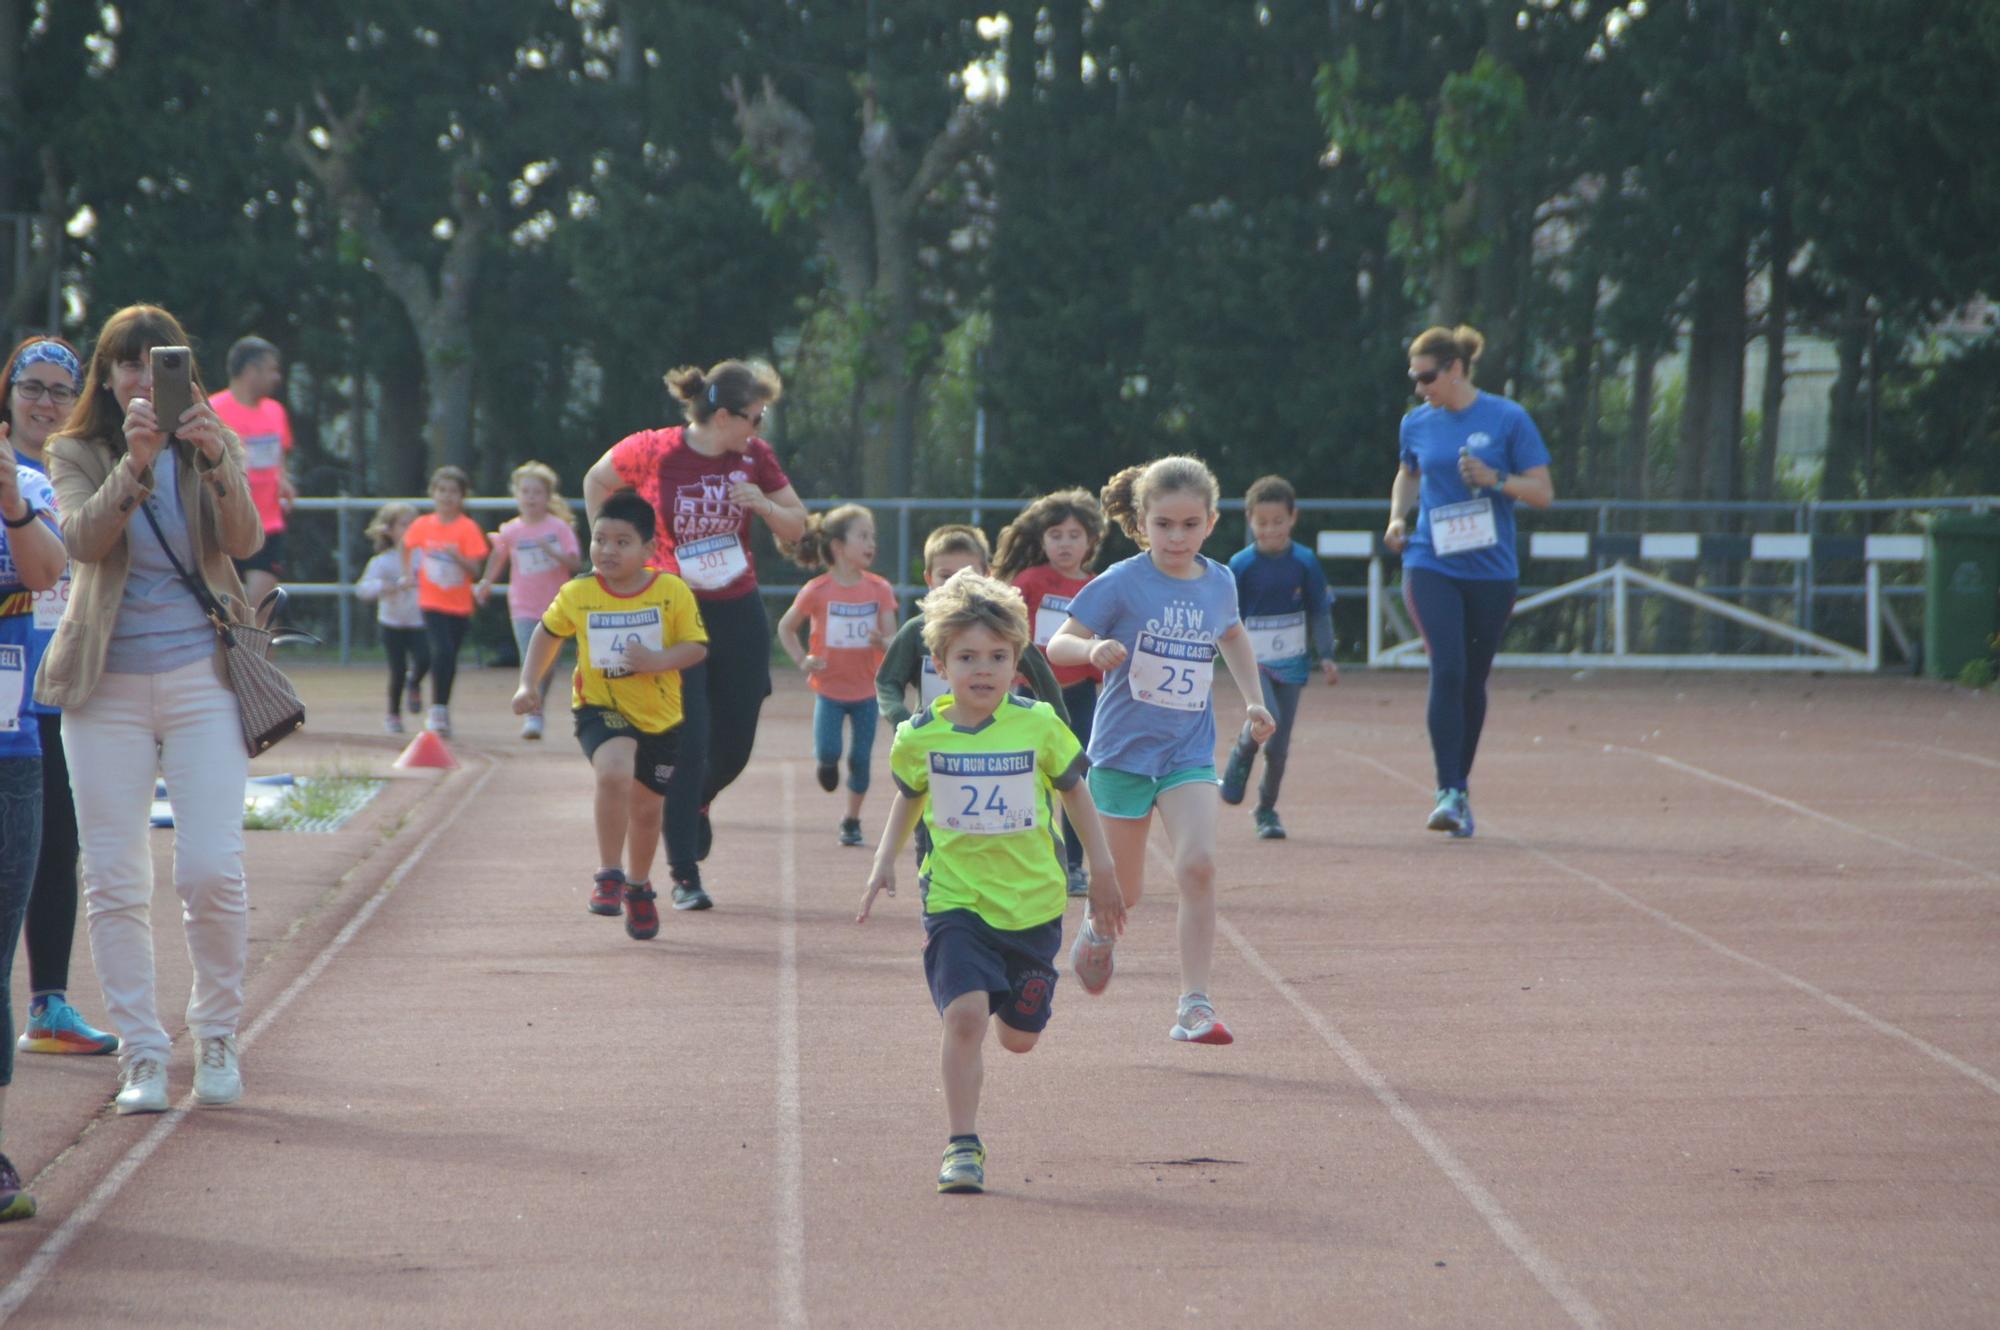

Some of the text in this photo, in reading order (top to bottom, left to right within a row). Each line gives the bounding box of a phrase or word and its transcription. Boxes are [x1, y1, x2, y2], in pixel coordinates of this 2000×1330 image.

[703, 485, 724, 500] XV
[680, 499, 744, 517] RUN
[696, 551, 728, 571] 301
[626, 612, 656, 625] CASTELL
[1163, 606, 1204, 630] NEW
[845, 621, 868, 639] 10
[1154, 640, 1168, 655] XV
[1168, 642, 1186, 657] RUN
[1272, 634, 1285, 651] 6
[1157, 665, 1196, 695] 25
[947, 754, 1030, 772] XV RUN CASTELL
[960, 784, 1008, 816] 24
